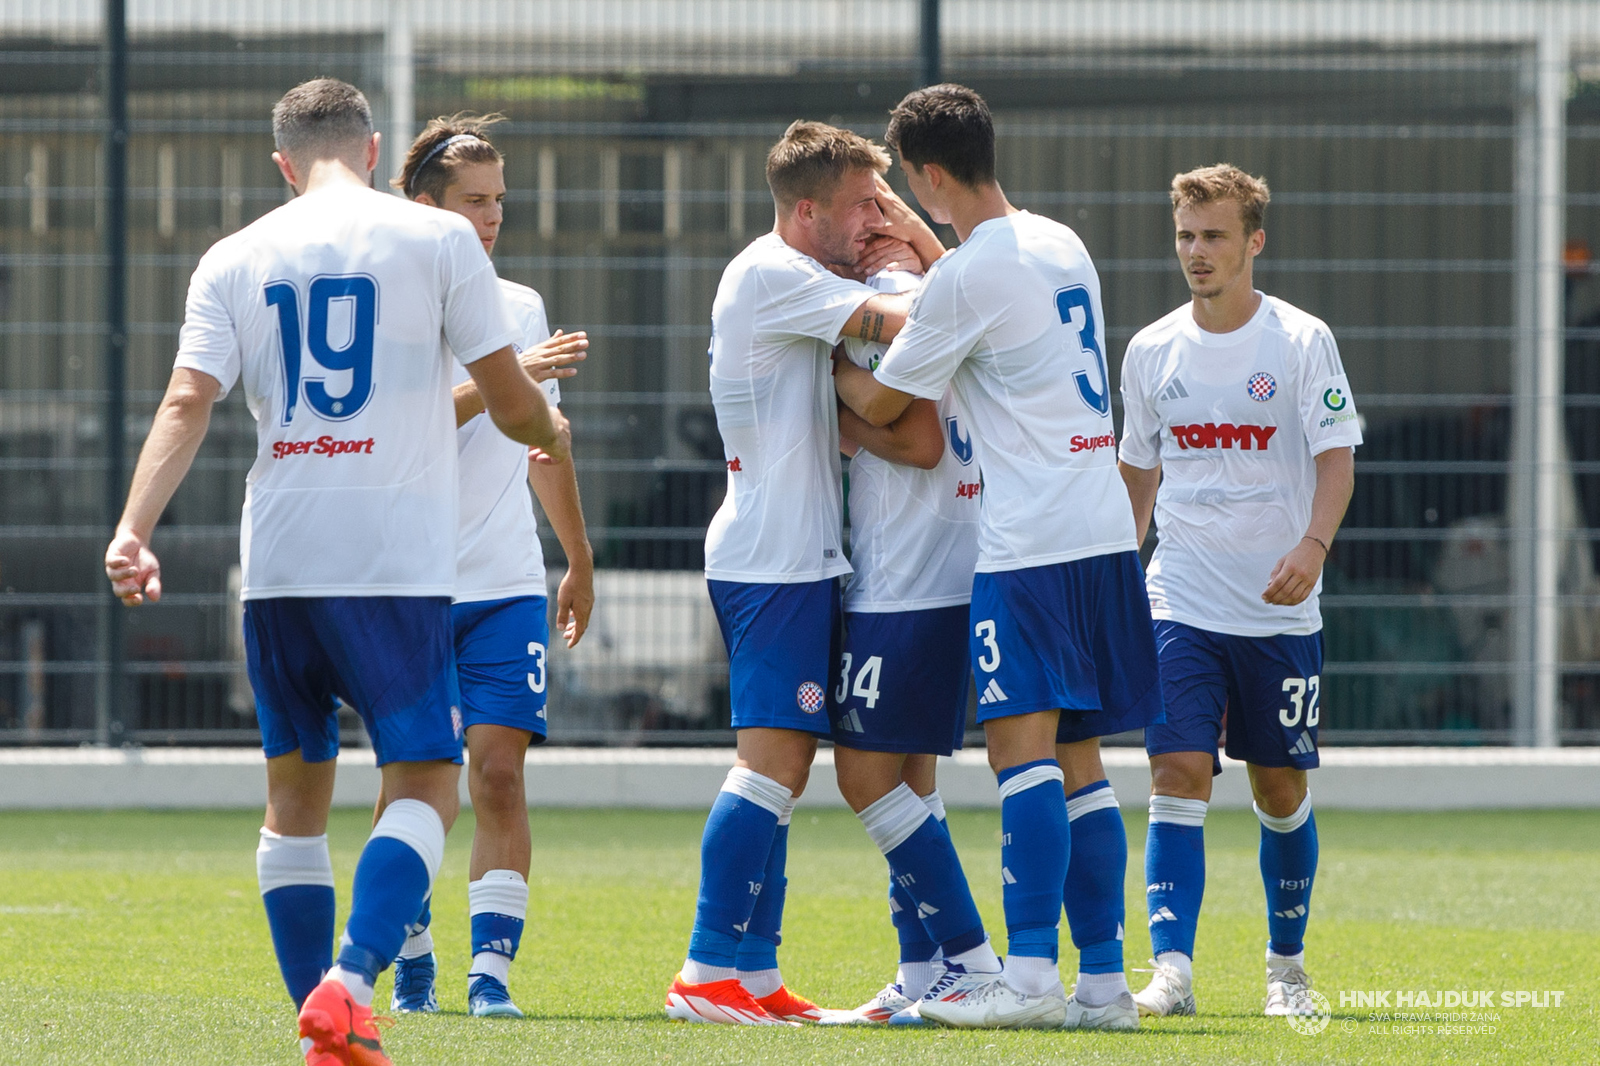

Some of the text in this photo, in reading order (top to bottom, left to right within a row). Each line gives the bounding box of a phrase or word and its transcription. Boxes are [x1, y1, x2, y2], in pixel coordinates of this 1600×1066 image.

[264, 273, 380, 426] 19
[1053, 286, 1110, 418] 3
[1170, 423, 1277, 450] TOMMY
[1320, 411, 1356, 428] otpbank
[272, 435, 375, 459] SperSport
[527, 641, 548, 694] 3
[975, 619, 1001, 673] 3
[835, 652, 883, 708] 34
[1279, 675, 1319, 727] 32
[1279, 877, 1310, 891] 1911
